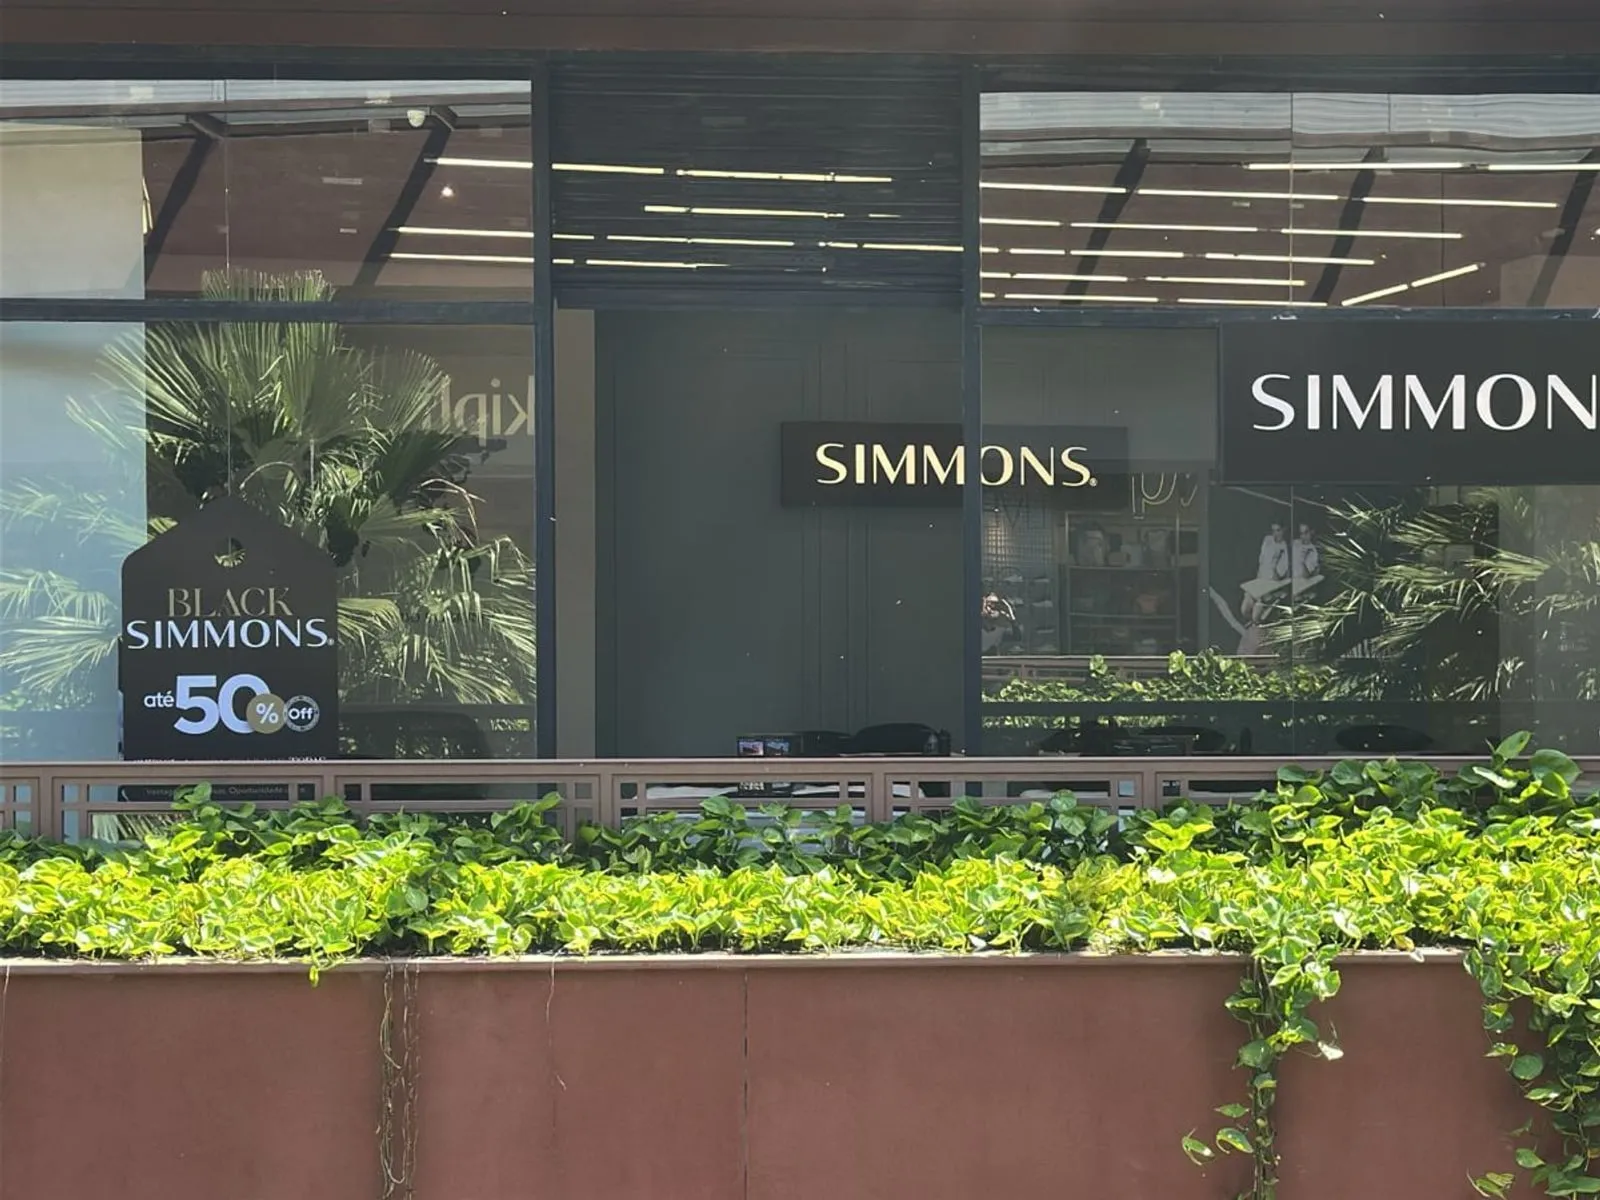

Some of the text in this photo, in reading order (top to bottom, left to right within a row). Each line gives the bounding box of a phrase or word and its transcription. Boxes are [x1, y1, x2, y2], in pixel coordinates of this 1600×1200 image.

[1251, 373, 1597, 431] SIMMON
[816, 442, 1091, 487] SIMMONS
[168, 587, 293, 617] BLACK
[126, 618, 328, 649] SIMMONS
[143, 691, 174, 708] até
[288, 708, 314, 720] Off
